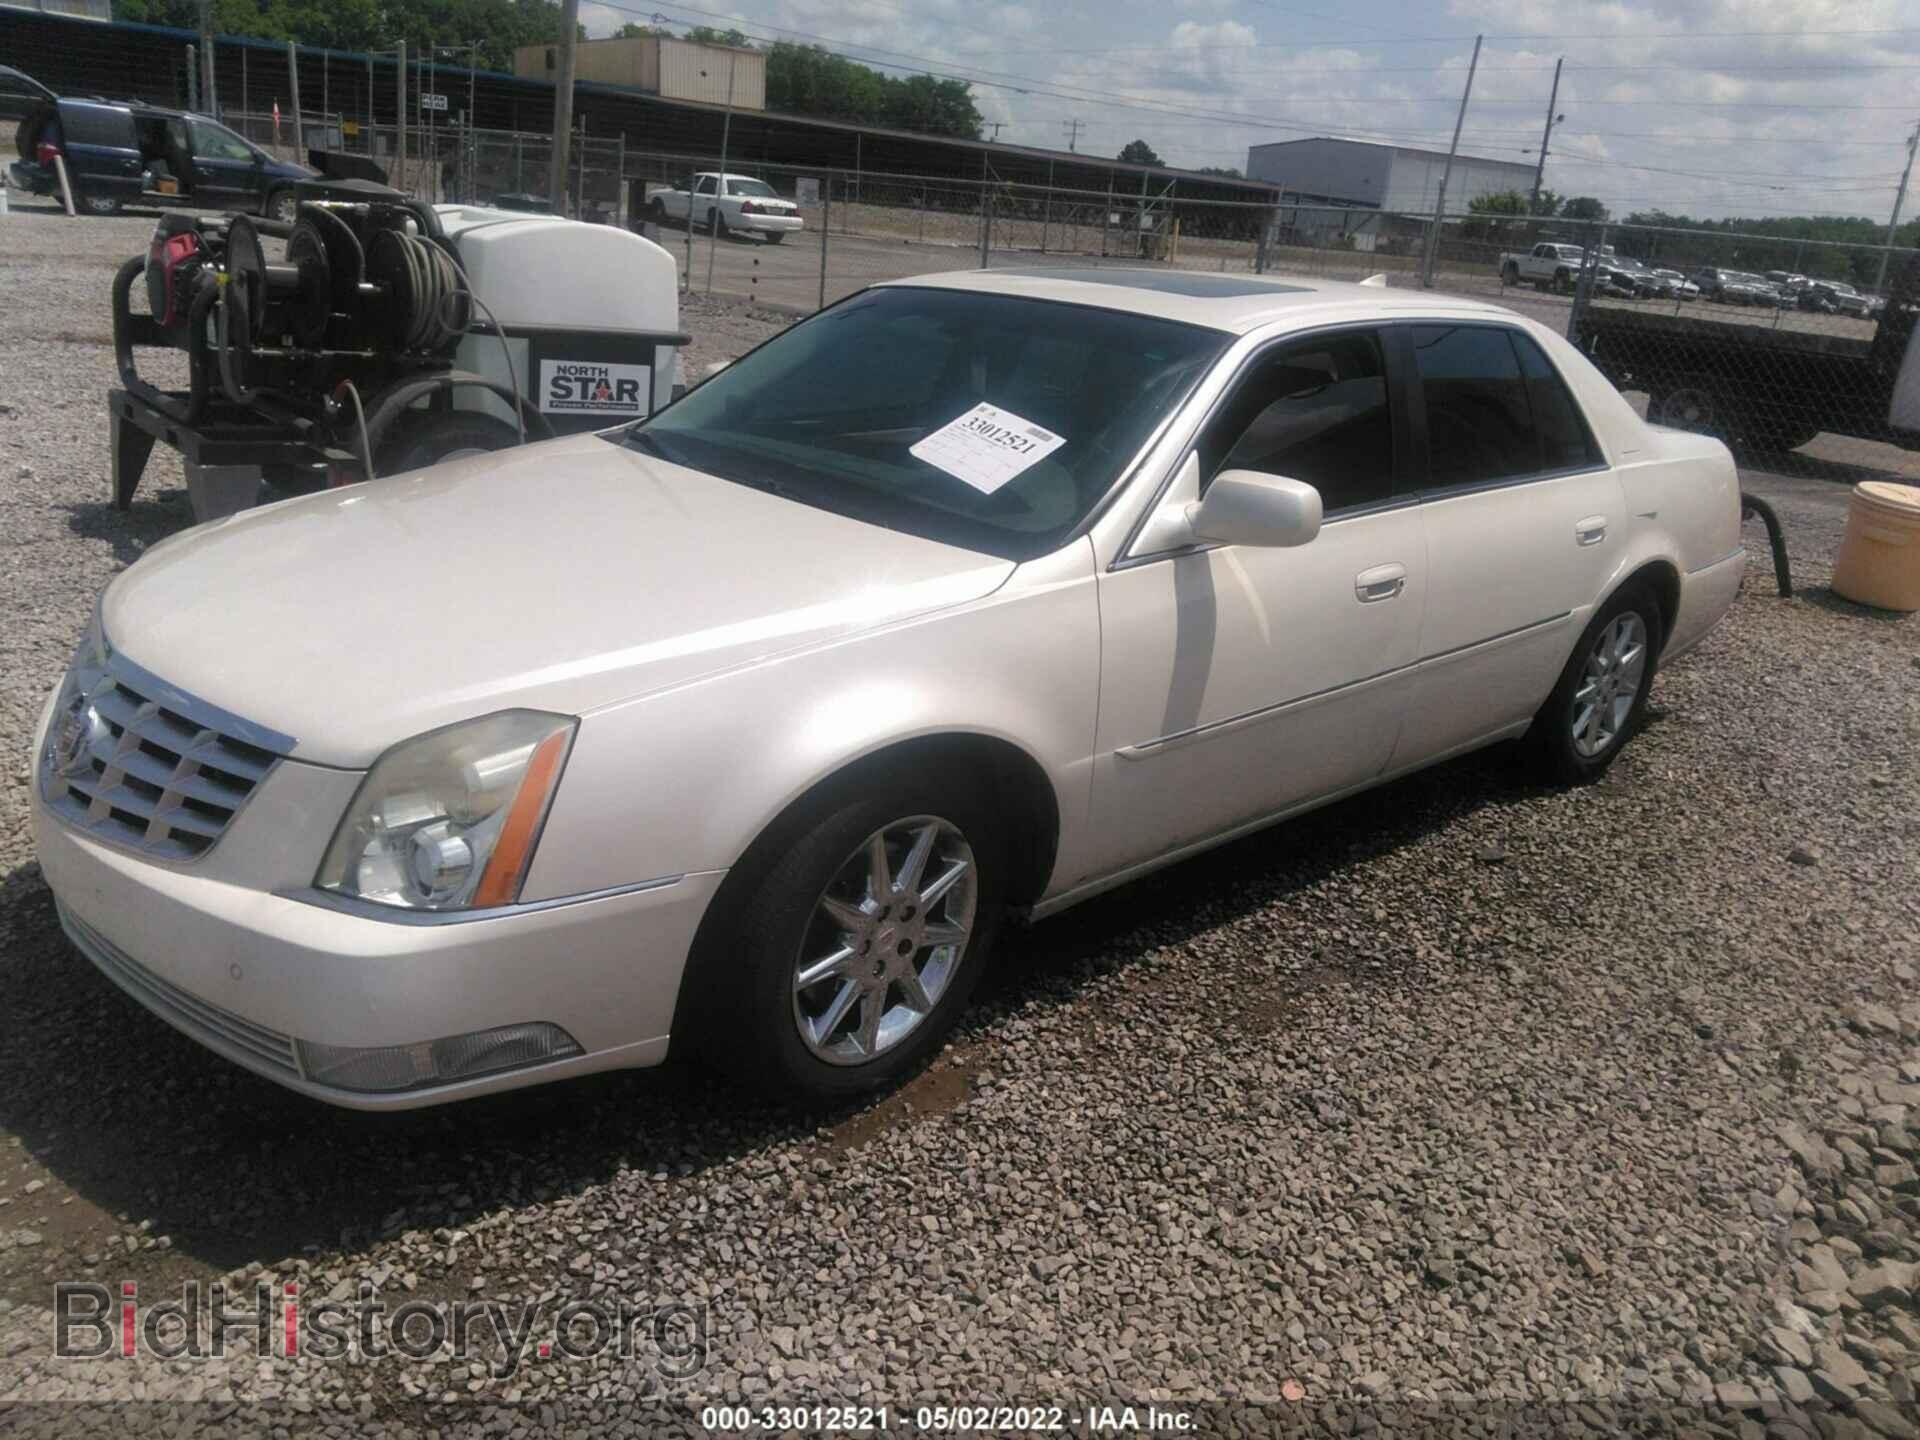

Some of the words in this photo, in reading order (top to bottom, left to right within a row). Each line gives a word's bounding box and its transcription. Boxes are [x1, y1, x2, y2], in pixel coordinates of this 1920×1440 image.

[556, 365, 608, 376] NORTH
[550, 375, 640, 402] STAR
[962, 417, 1036, 454] 33012521
